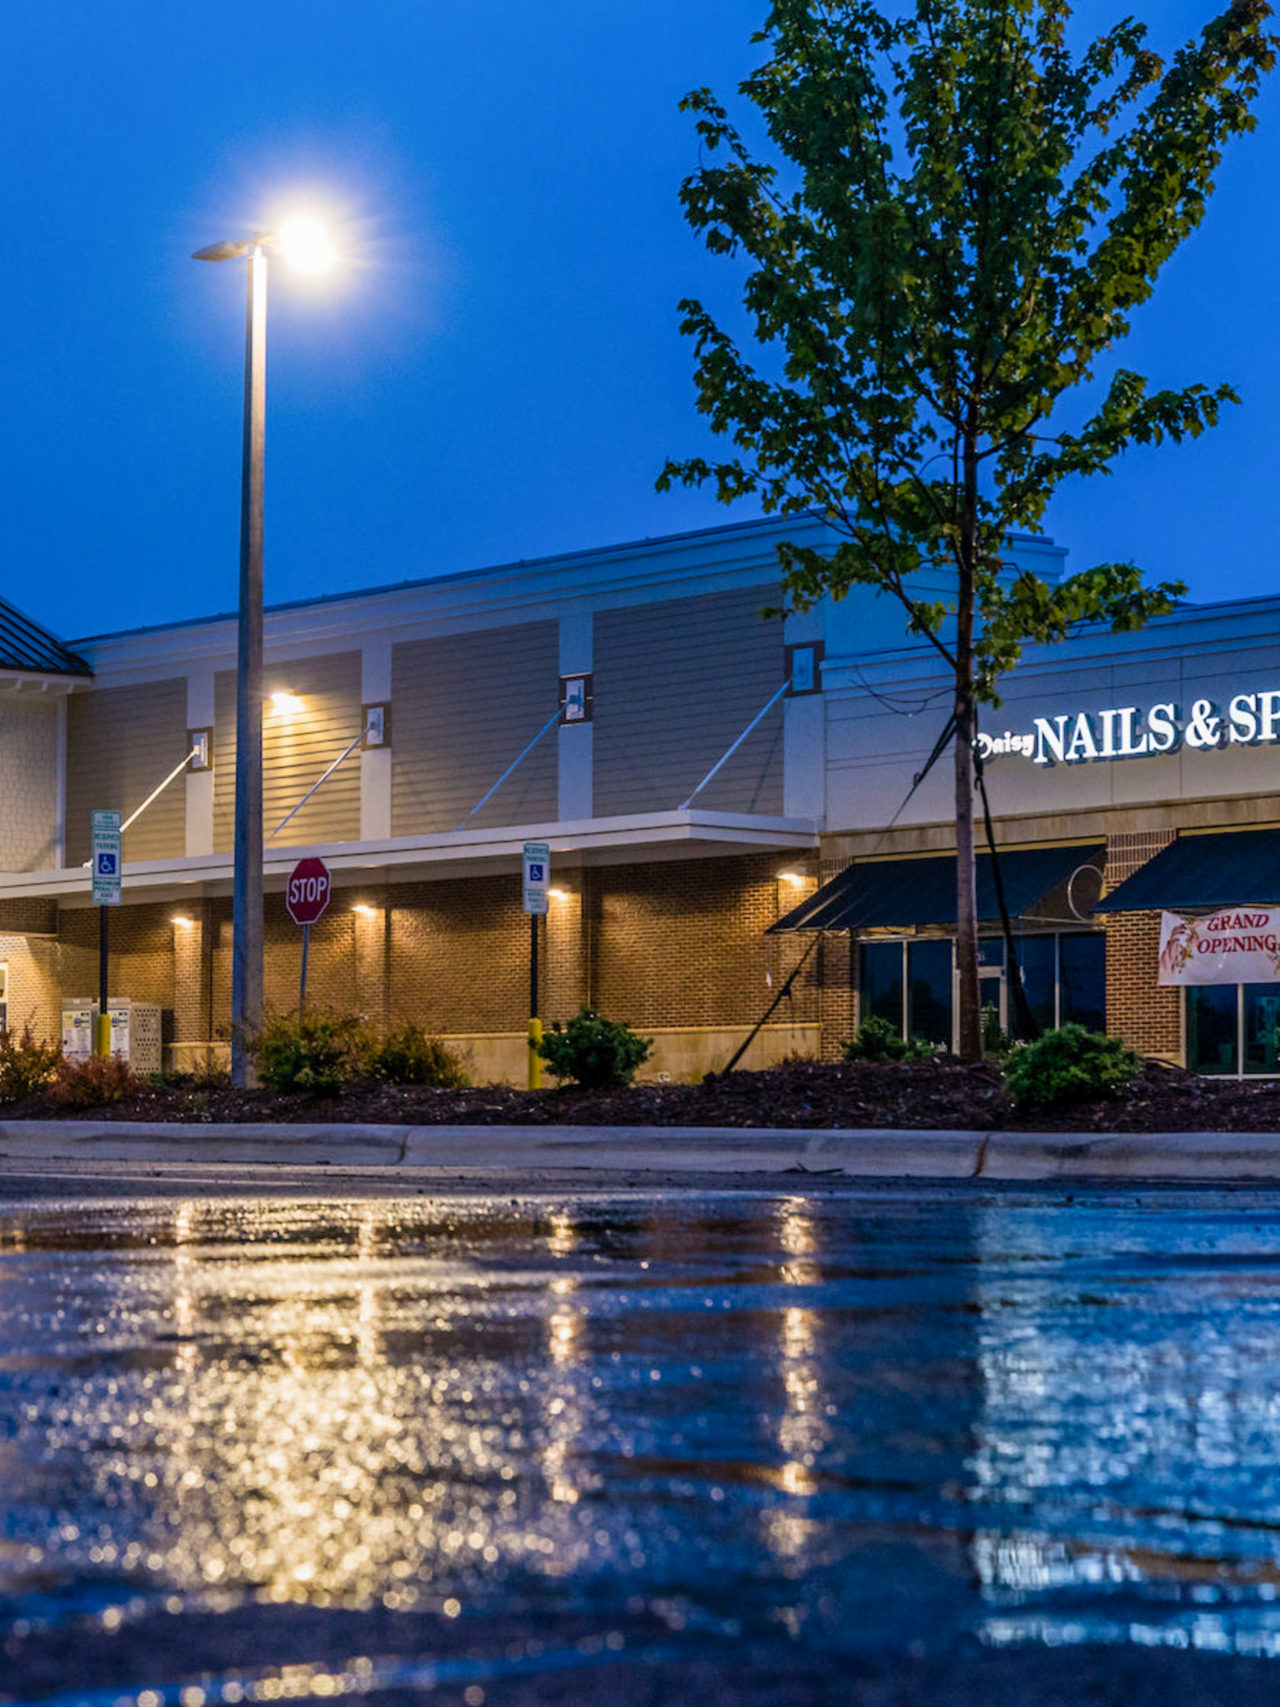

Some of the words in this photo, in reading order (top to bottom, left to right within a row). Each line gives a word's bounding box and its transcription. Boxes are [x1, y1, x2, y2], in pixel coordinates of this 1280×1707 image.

[971, 731, 1035, 758] Daisy
[1033, 706, 1176, 763] NAILS
[1184, 699, 1221, 748] &
[289, 876, 327, 904] STOP
[1206, 913, 1270, 932] GRAND
[1197, 934, 1278, 954] OPENING
